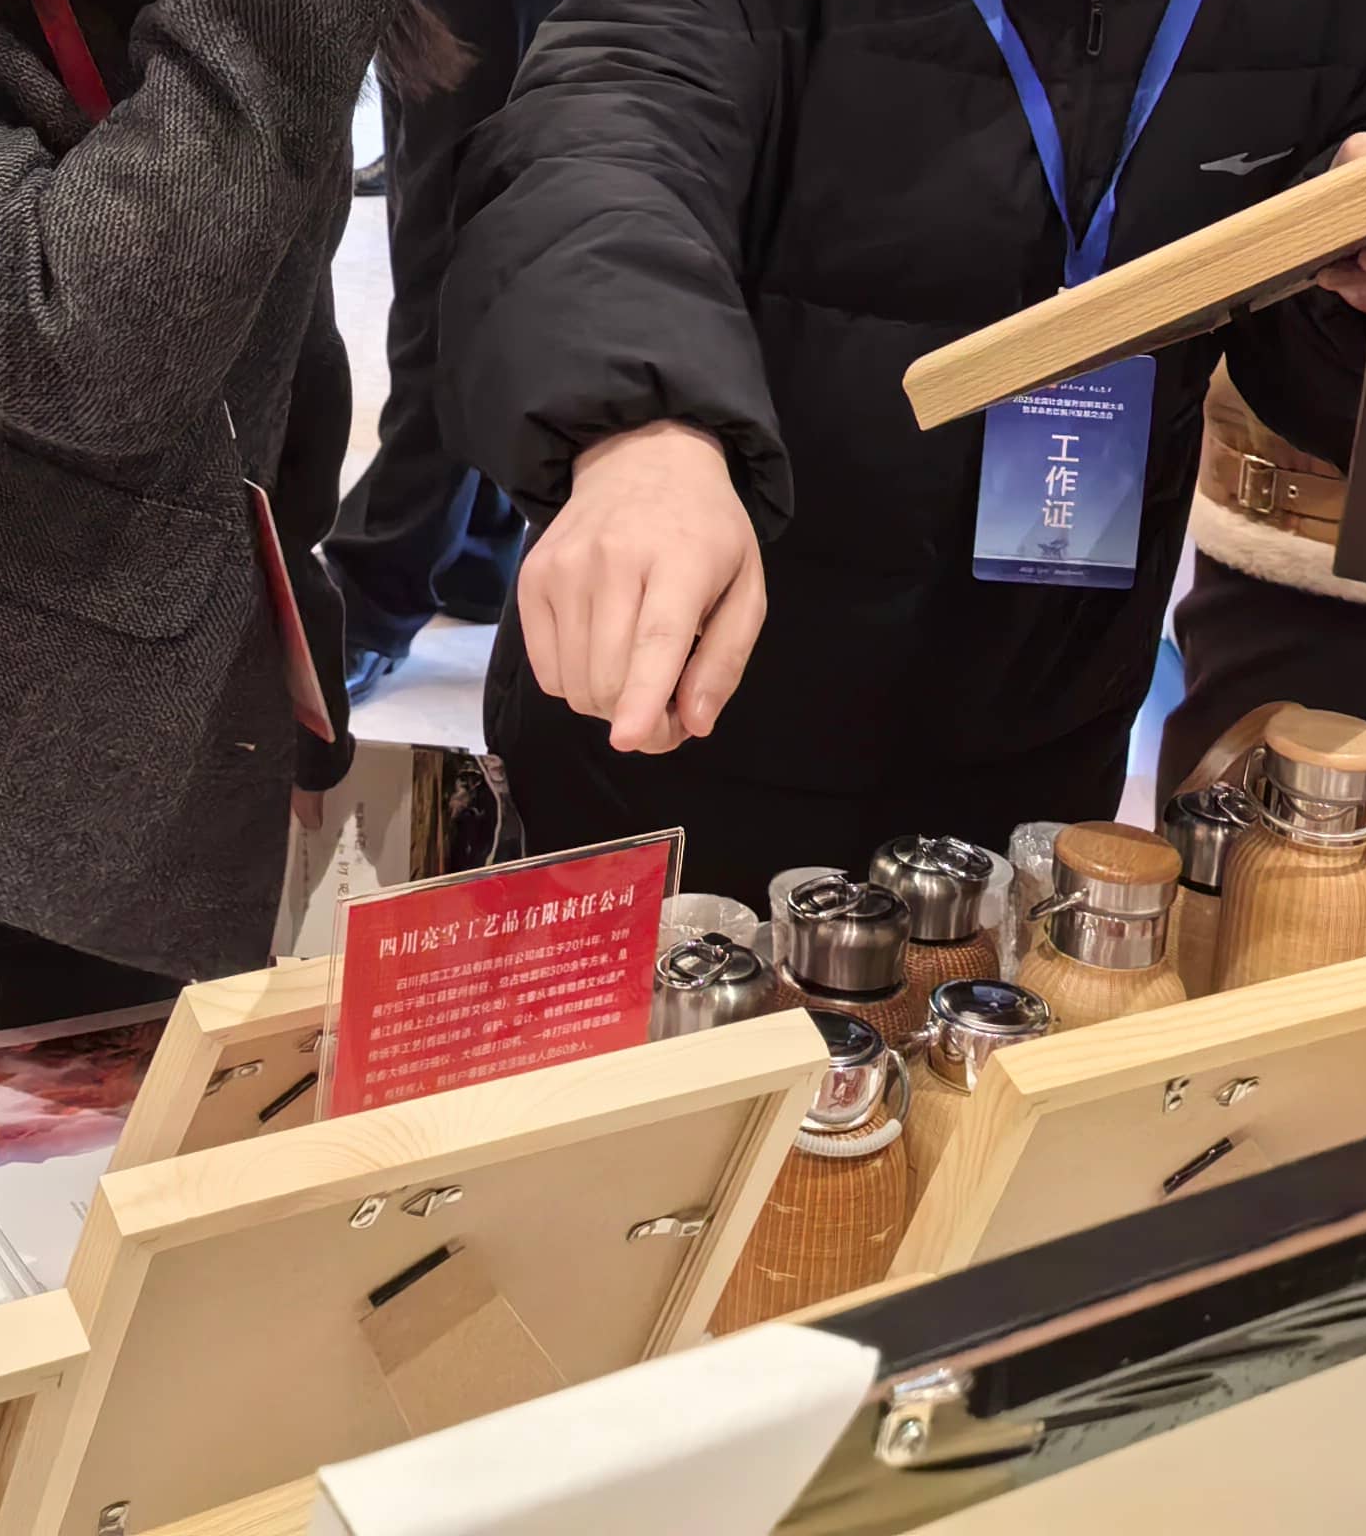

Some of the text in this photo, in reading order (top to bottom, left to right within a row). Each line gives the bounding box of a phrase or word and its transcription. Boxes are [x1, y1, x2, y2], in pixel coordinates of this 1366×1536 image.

[1042, 434, 1080, 529] 工作证
[379, 884, 635, 959] 四川亮雪工艺品有限责任公司
